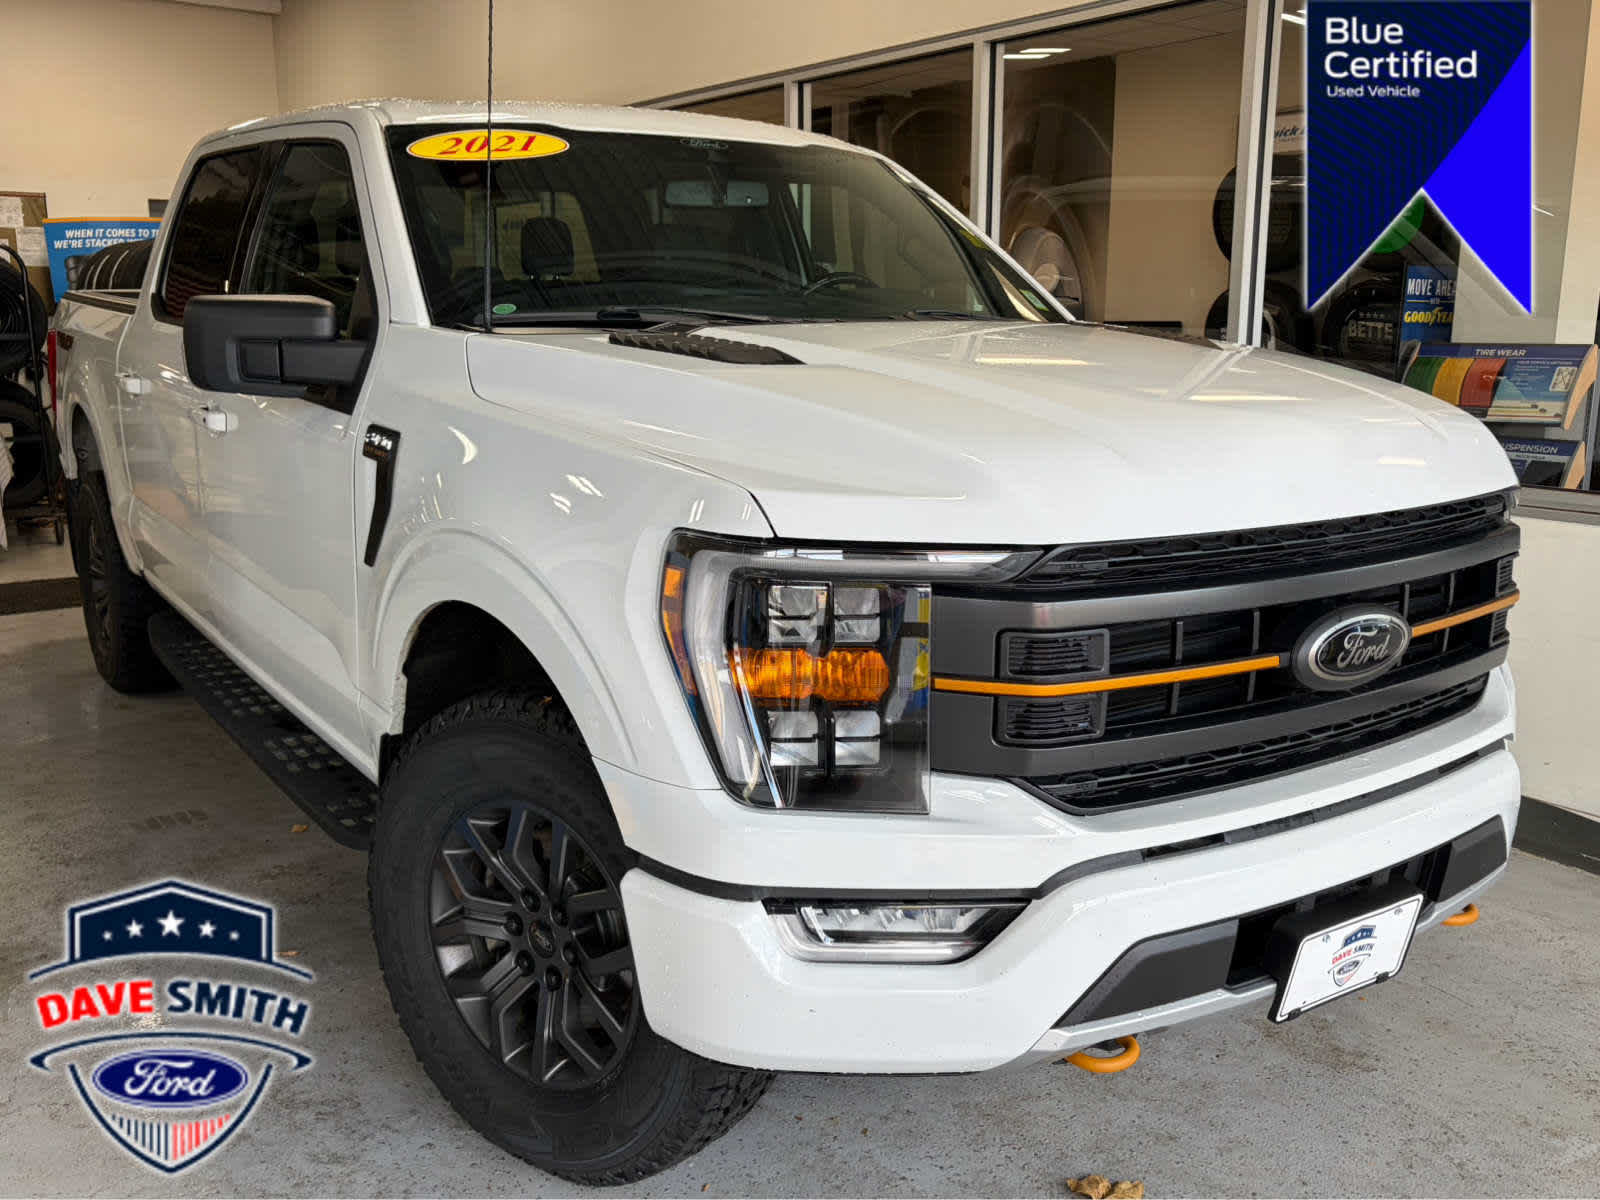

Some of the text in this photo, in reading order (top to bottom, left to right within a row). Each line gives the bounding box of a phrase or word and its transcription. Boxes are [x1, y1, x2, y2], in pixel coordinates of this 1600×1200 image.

[436, 135, 536, 155] 2021
[65, 229, 93, 238] WHEN
[95, 229, 104, 238] IT
[106, 229, 136, 238] COMES
[138, 229, 150, 238] TO
[54, 239, 83, 249] WE'RE
[1407, 279, 1433, 296] MOVE
[1336, 628, 1390, 669] Ford
